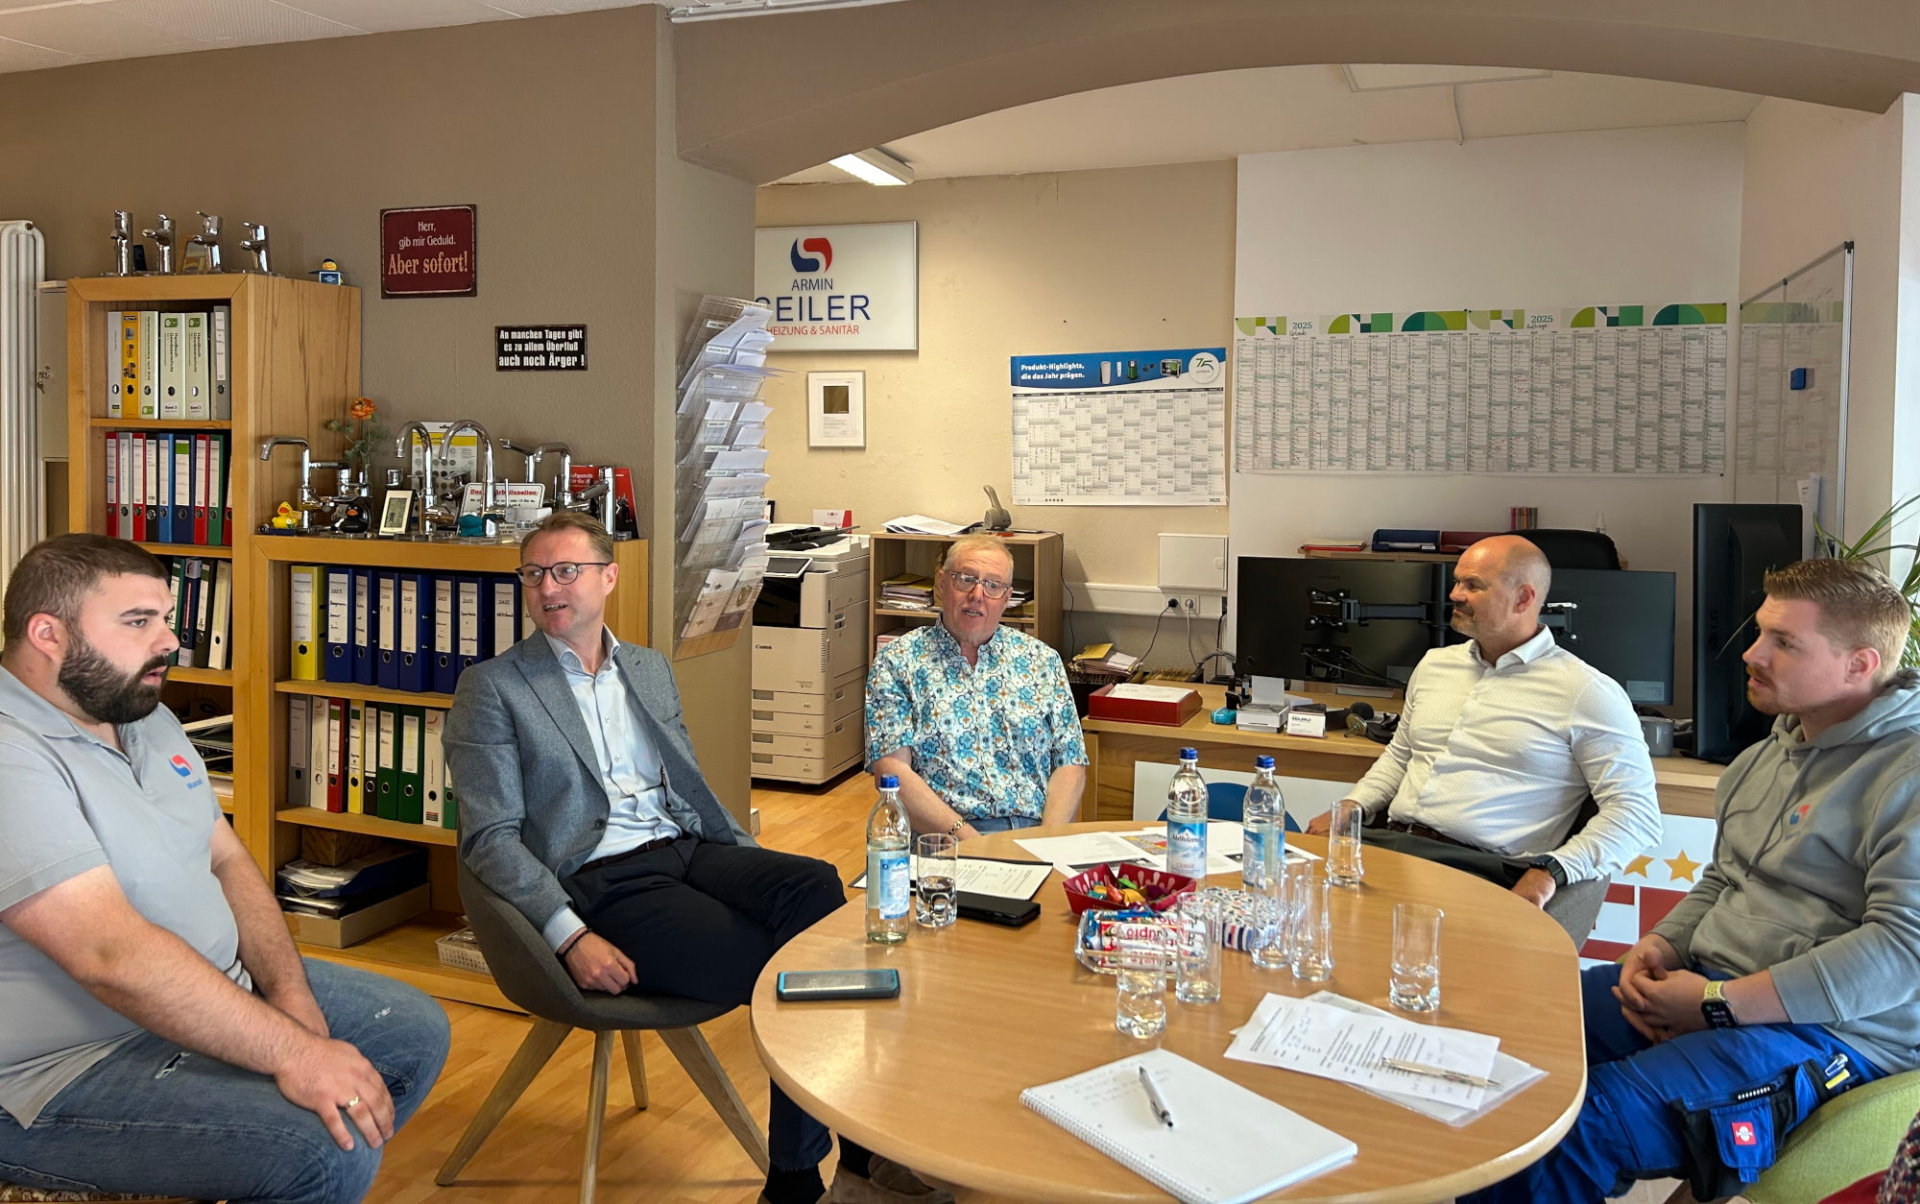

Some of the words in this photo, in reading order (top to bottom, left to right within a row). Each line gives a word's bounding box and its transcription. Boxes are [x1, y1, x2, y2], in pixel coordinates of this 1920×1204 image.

[417, 221, 436, 232] Herr,
[398, 236, 411, 250] gib
[412, 236, 425, 247] mir
[427, 234, 456, 246] Geduld.
[388, 253, 419, 275] Aber
[423, 251, 468, 274] sofort!
[791, 278, 833, 291] ARMIN
[1530, 315, 1553, 323] 2025
[499, 330, 509, 340] An
[511, 330, 543, 339] manchen
[544, 329, 566, 340] Tagen
[567, 329, 583, 340] gibt
[810, 326, 817, 335] &
[819, 324, 859, 336] SANITÄR
[503, 343, 513, 352] es
[514, 343, 522, 352] zu
[524, 342, 545, 352] allem
[546, 340, 579, 352] Überfluß
[499, 354, 521, 367] auch
[523, 354, 545, 367] noch
[549, 352, 578, 368] Ärger
[581, 354, 585, 367] !
[1195, 357, 1215, 371] 75
[1020, 372, 1032, 380] die
[1045, 372, 1059, 380] Jahr
[1060, 371, 1085, 380] prägen.
